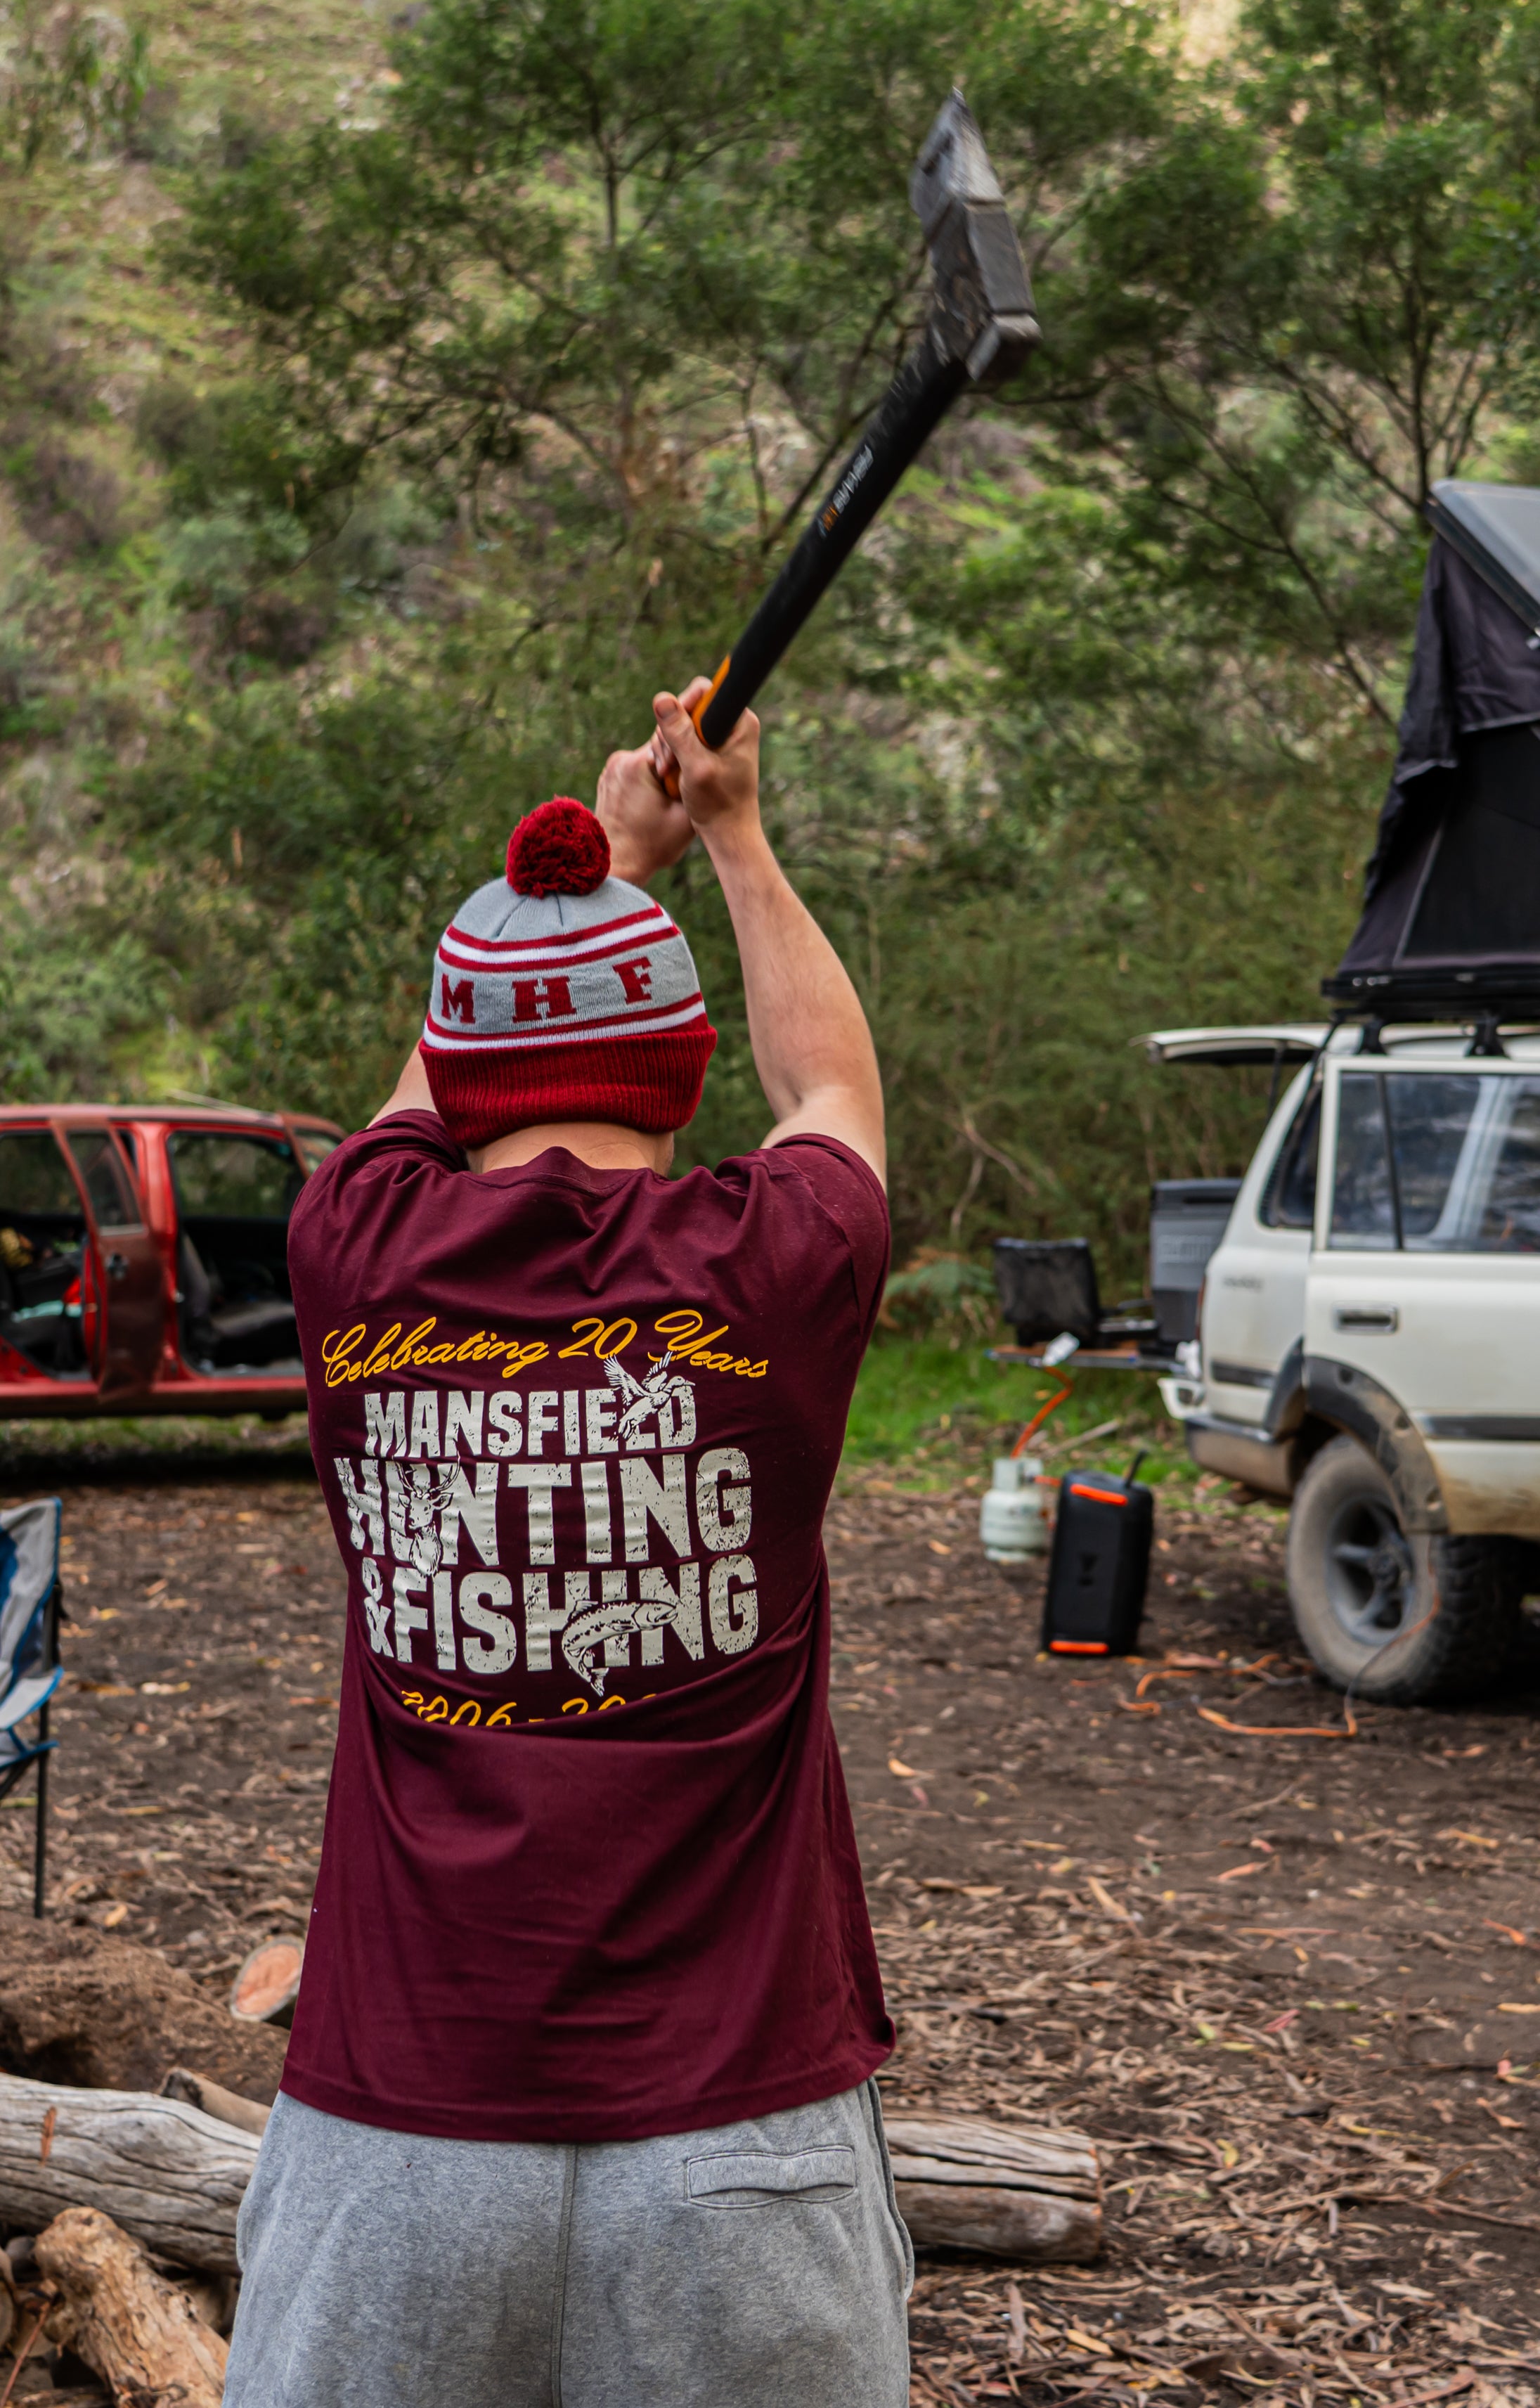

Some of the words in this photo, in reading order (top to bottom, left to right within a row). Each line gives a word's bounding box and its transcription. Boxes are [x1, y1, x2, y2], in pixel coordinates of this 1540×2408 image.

[322, 1316, 549, 1388] Celebrating
[557, 1317, 638, 1360] 20
[647, 1309, 769, 1378] Years
[333, 1447, 753, 1566] HUNTING
